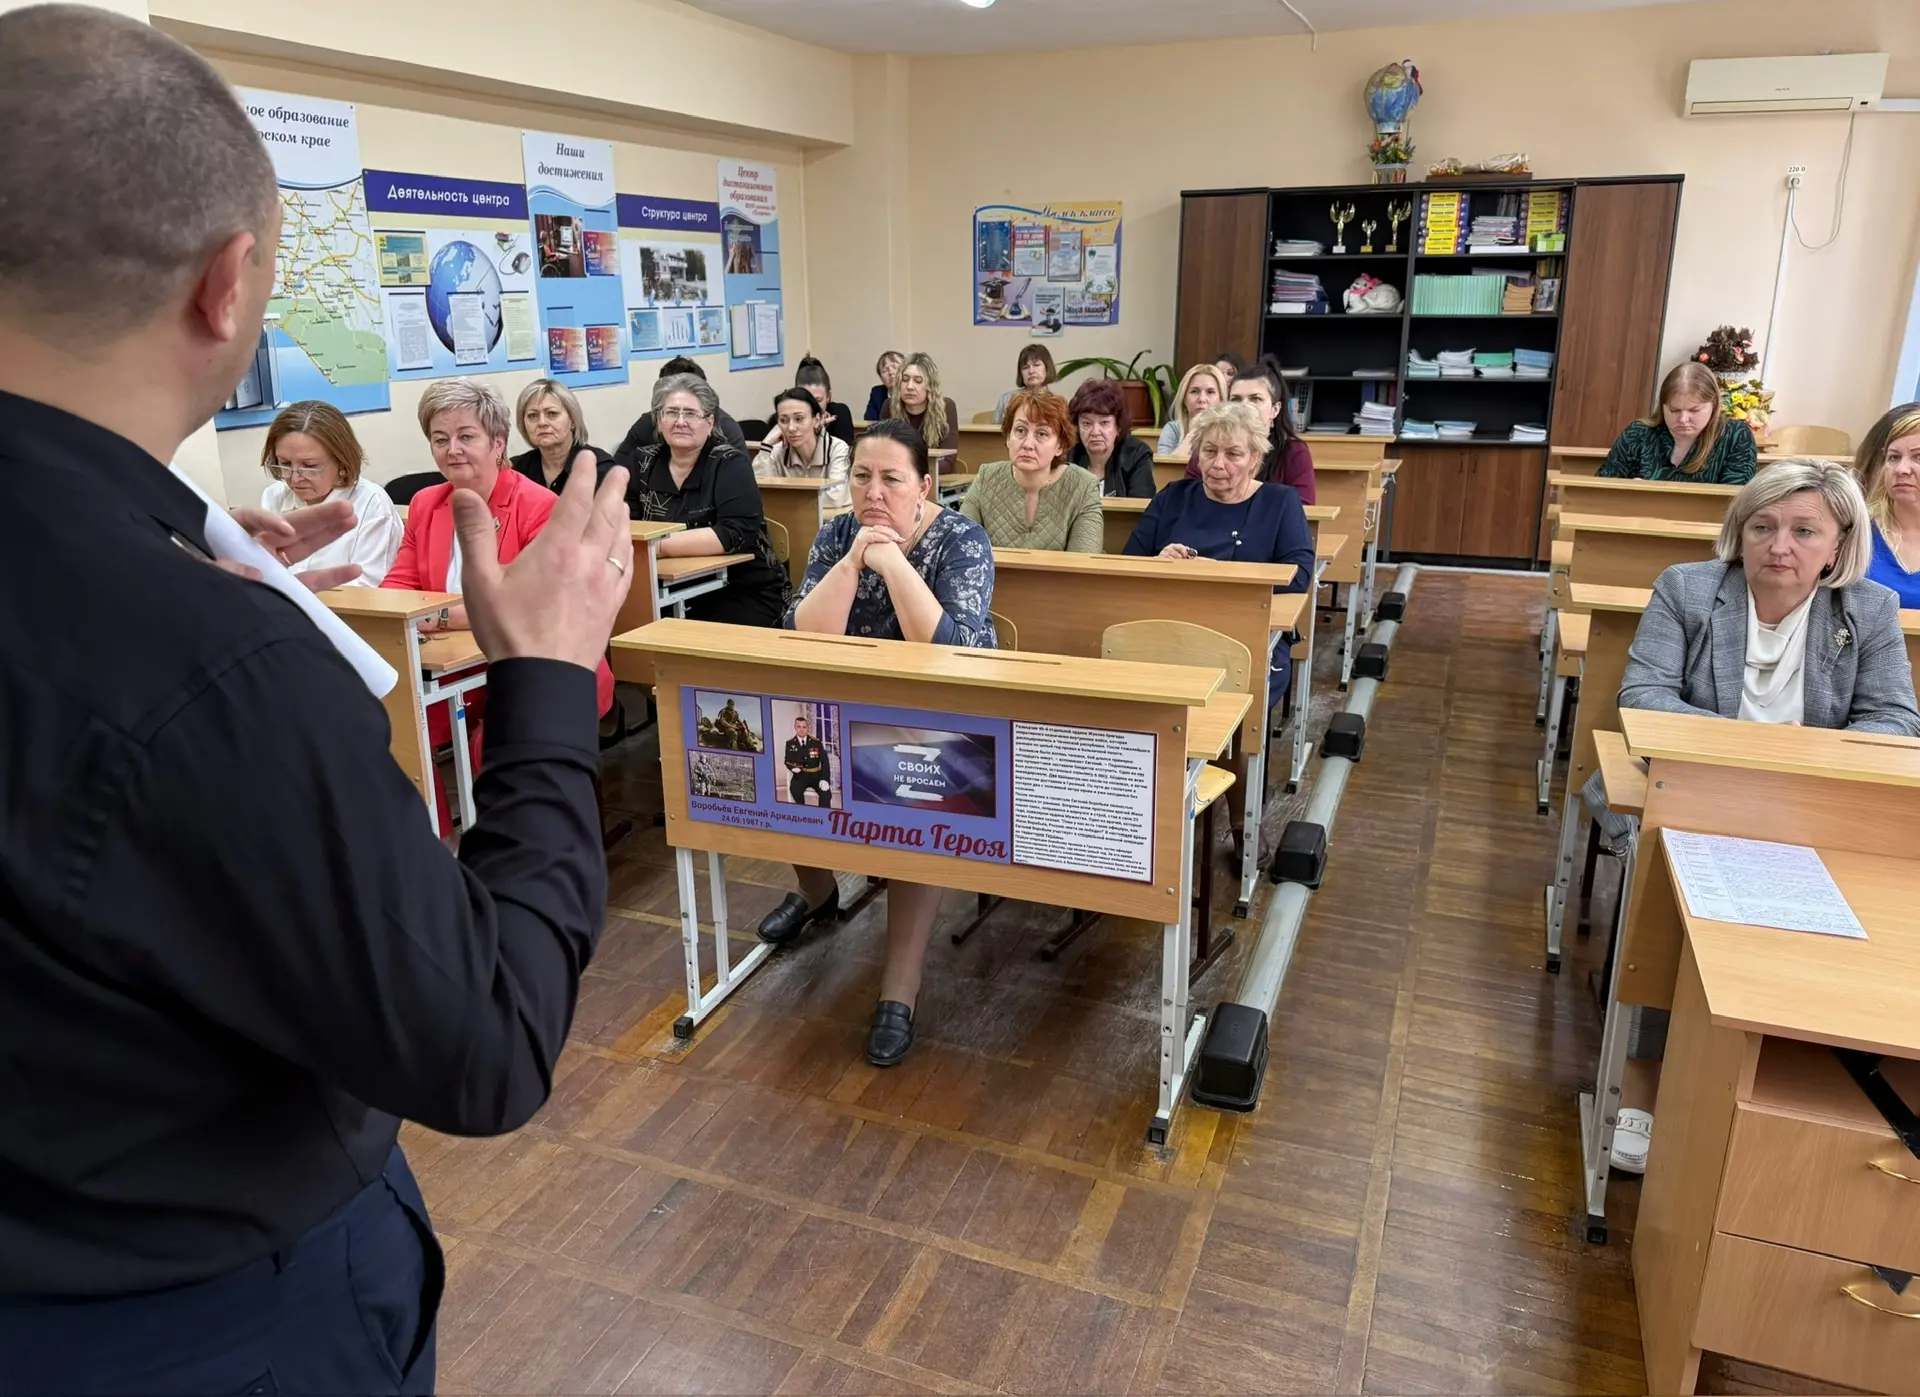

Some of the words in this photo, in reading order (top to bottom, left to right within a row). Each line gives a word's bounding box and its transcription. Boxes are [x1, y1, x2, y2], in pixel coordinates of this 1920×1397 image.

[268, 105, 350, 128] образование
[301, 135, 331, 148] крае
[556, 142, 585, 158] Наши
[538, 162, 604, 181] достижения
[737, 166, 759, 181] Центр
[387, 184, 468, 203] Деятельность
[472, 193, 510, 208] центра
[641, 206, 680, 221] Структура
[682, 211, 708, 223] центра
[898, 761, 941, 775] СВОИХ
[893, 774, 905, 783] НЕ
[906, 776, 946, 788] БРОСАЕМ
[691, 800, 732, 813] Воробьёв
[733, 806, 769, 818] Евгений
[770, 811, 824, 825] Аркадьевич
[721, 815, 759, 826] 24.09.1987
[760, 821, 772, 829] г.р.
[828, 811, 925, 845] Парта
[930, 823, 1008, 859] Героя
